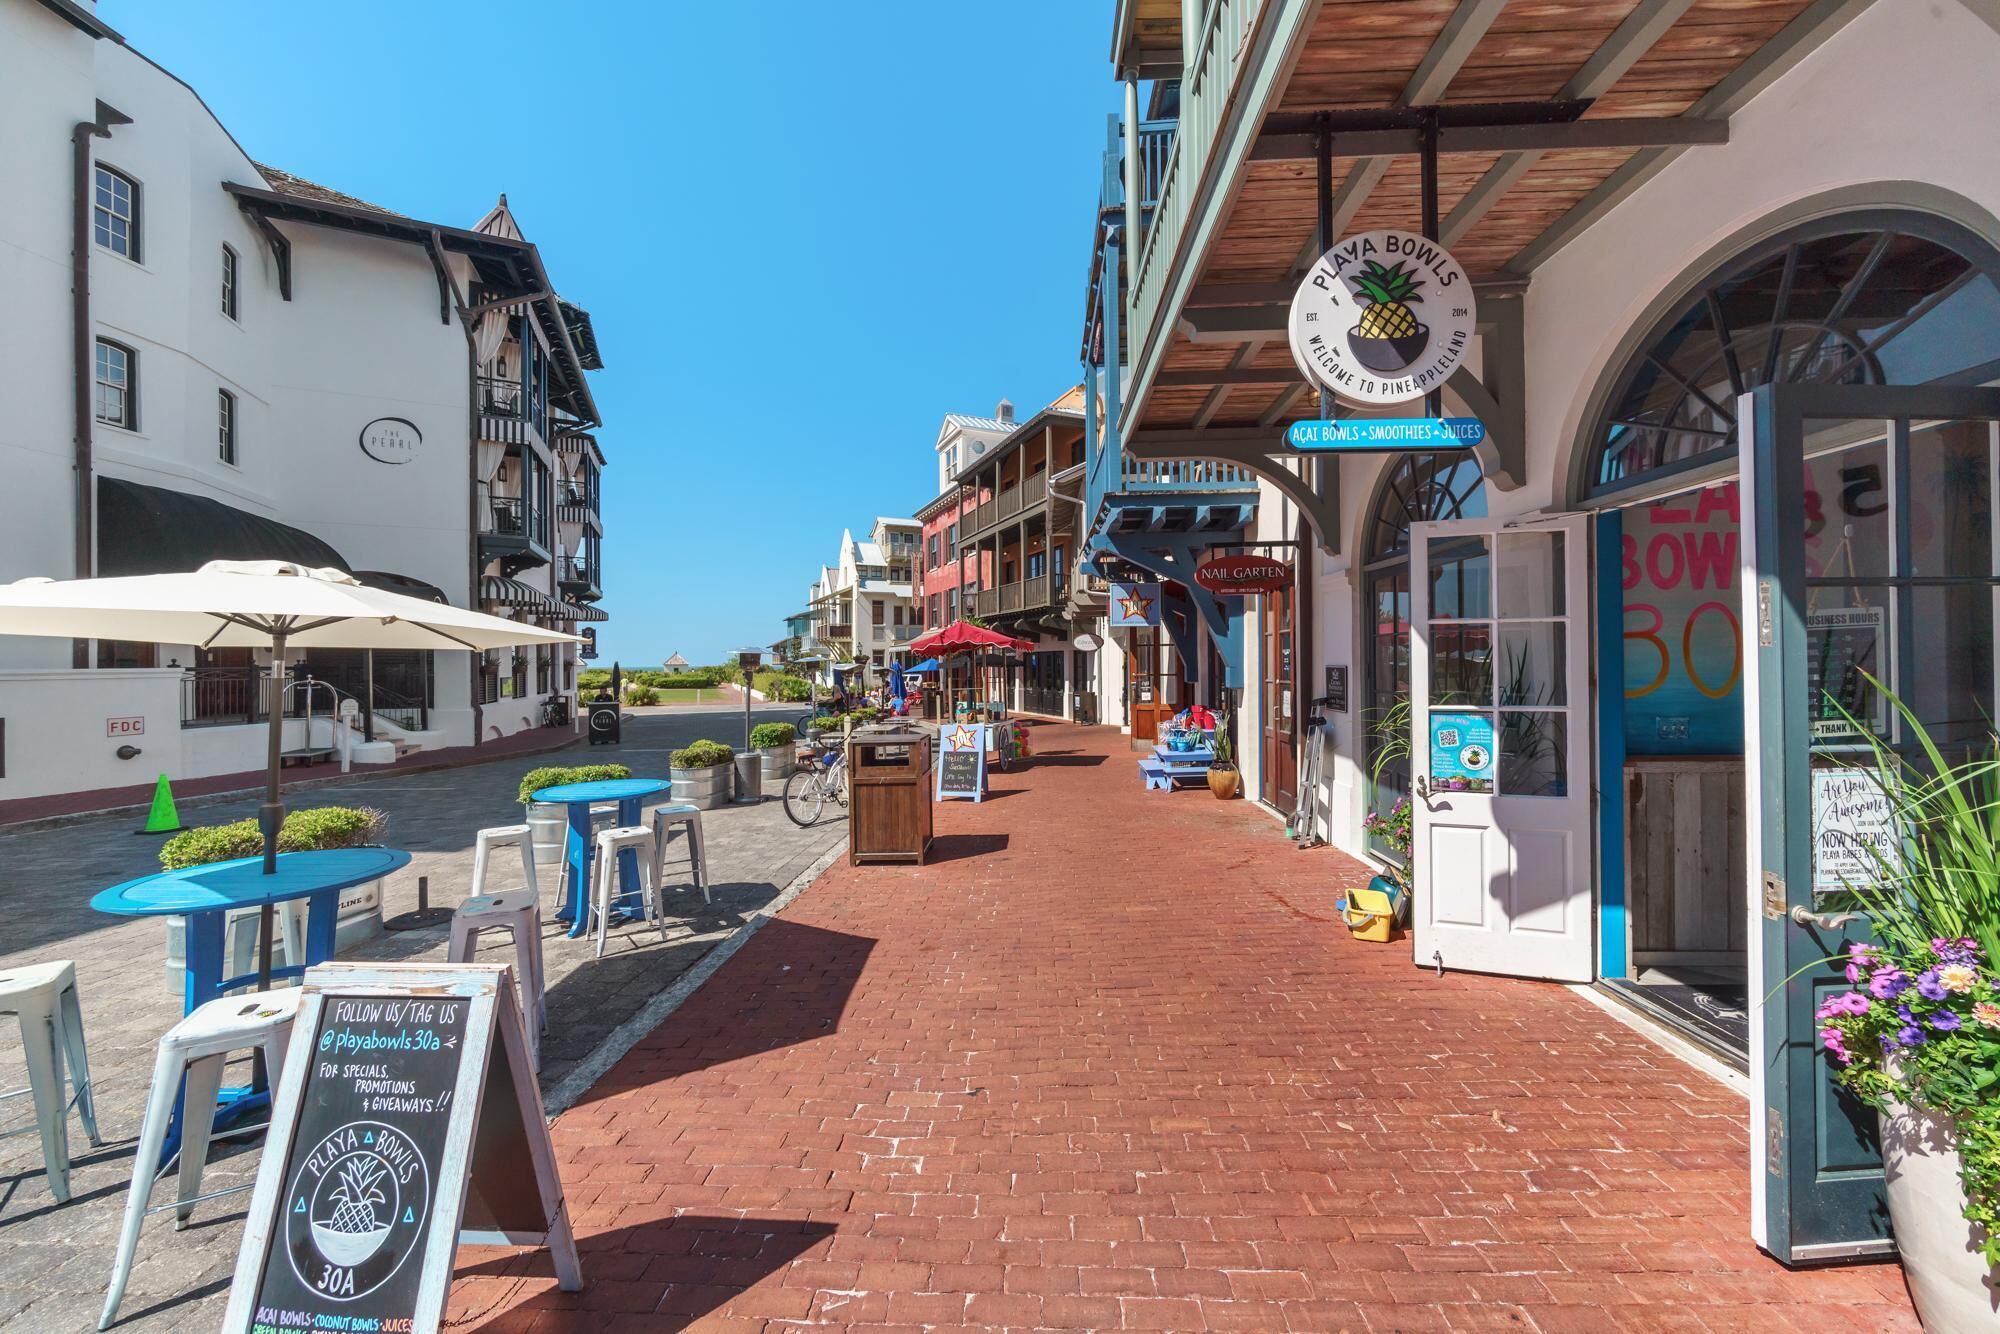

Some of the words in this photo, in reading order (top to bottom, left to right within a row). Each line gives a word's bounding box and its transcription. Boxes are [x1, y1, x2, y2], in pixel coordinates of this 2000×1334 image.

[1312, 238, 1378, 291] PLAYA
[1385, 235, 1459, 287] BOWLS
[1306, 313, 1319, 322] EST.
[1452, 308, 1468, 317] 2014
[1308, 334, 1353, 387] WELCOME
[1359, 379, 1374, 394] TO
[1381, 330, 1467, 395] PINEAPPLELAND
[1292, 426, 1318, 443] AÇAI
[1322, 426, 1360, 441] BOWLS
[1368, 425, 1431, 440] SMOOTHIES
[1441, 424, 1481, 439] JUICES
[372, 436, 412, 450] PEARL
[1201, 568, 1230, 579] NAIL
[1233, 566, 1285, 578] GARTEN
[1807, 614, 1847, 625] USINESS
[1849, 612, 1879, 623] HOURS
[110, 721, 142, 733] FDC
[1821, 724, 1847, 734] THANK
[1821, 780, 1841, 801] Are
[1843, 779, 1866, 802] You
[1829, 796, 1889, 822] Awesome!
[1822, 832, 1846, 849] NOW
[1851, 831, 1887, 847] HIRING
[1823, 850, 1840, 860] PLAYA
[1842, 849, 1862, 859] BABES
[335, 1001, 381, 1024] FOLLOW
[440, 1003, 458, 1024] US
[320, 1027, 440, 1055] @playabowls30a
[320, 1063, 338, 1078] FOR
[343, 1064, 389, 1080] SPECIALS,
[355, 1079, 415, 1095] PROMOTIONS
[309, 1129, 358, 1178] PLAYA
[375, 1130, 419, 1184] BOWLS
[317, 1264, 355, 1295] 30A
[256, 1306, 278, 1325] ACAI
[280, 1310, 312, 1326] BOWLS
[314, 1314, 353, 1331] COCONUT
[352, 1318, 379, 1331] BOWLS
[382, 1318, 413, 1332] JUICES
